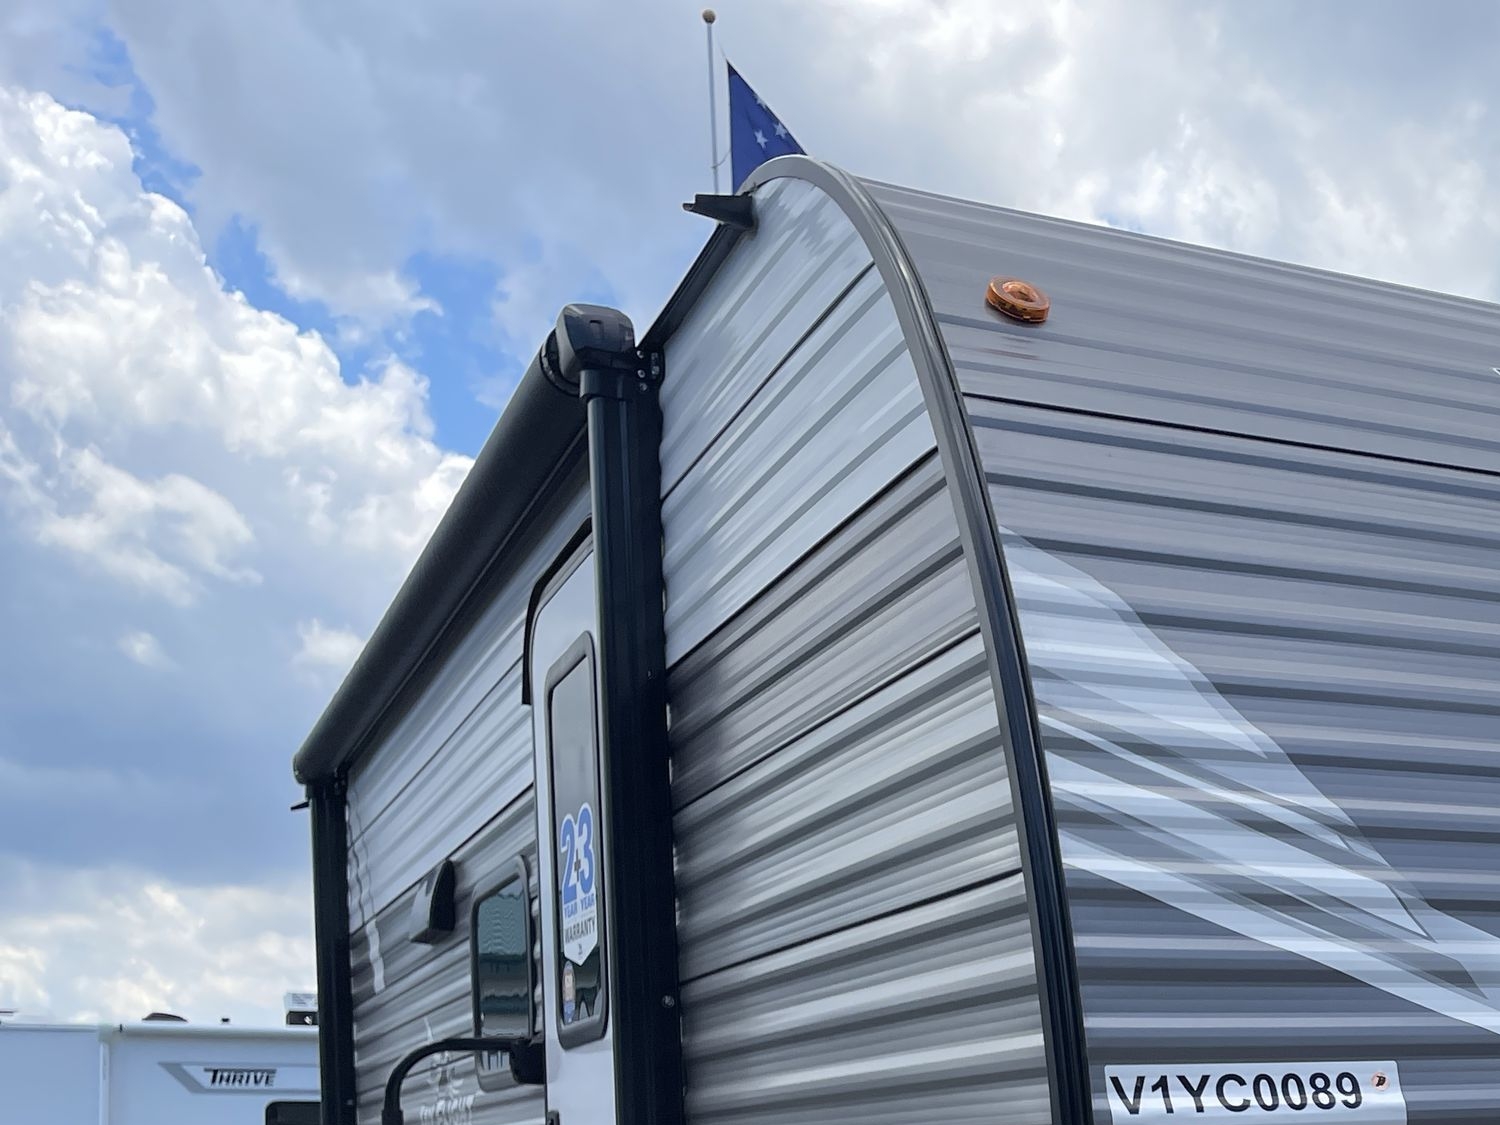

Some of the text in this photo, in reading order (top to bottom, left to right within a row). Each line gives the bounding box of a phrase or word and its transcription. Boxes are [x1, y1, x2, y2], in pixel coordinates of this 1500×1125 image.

[564, 915, 596, 943] WARRANTY
[203, 1067, 277, 1086] THRIVE
[1109, 1071, 1363, 1115] V1YC0089
